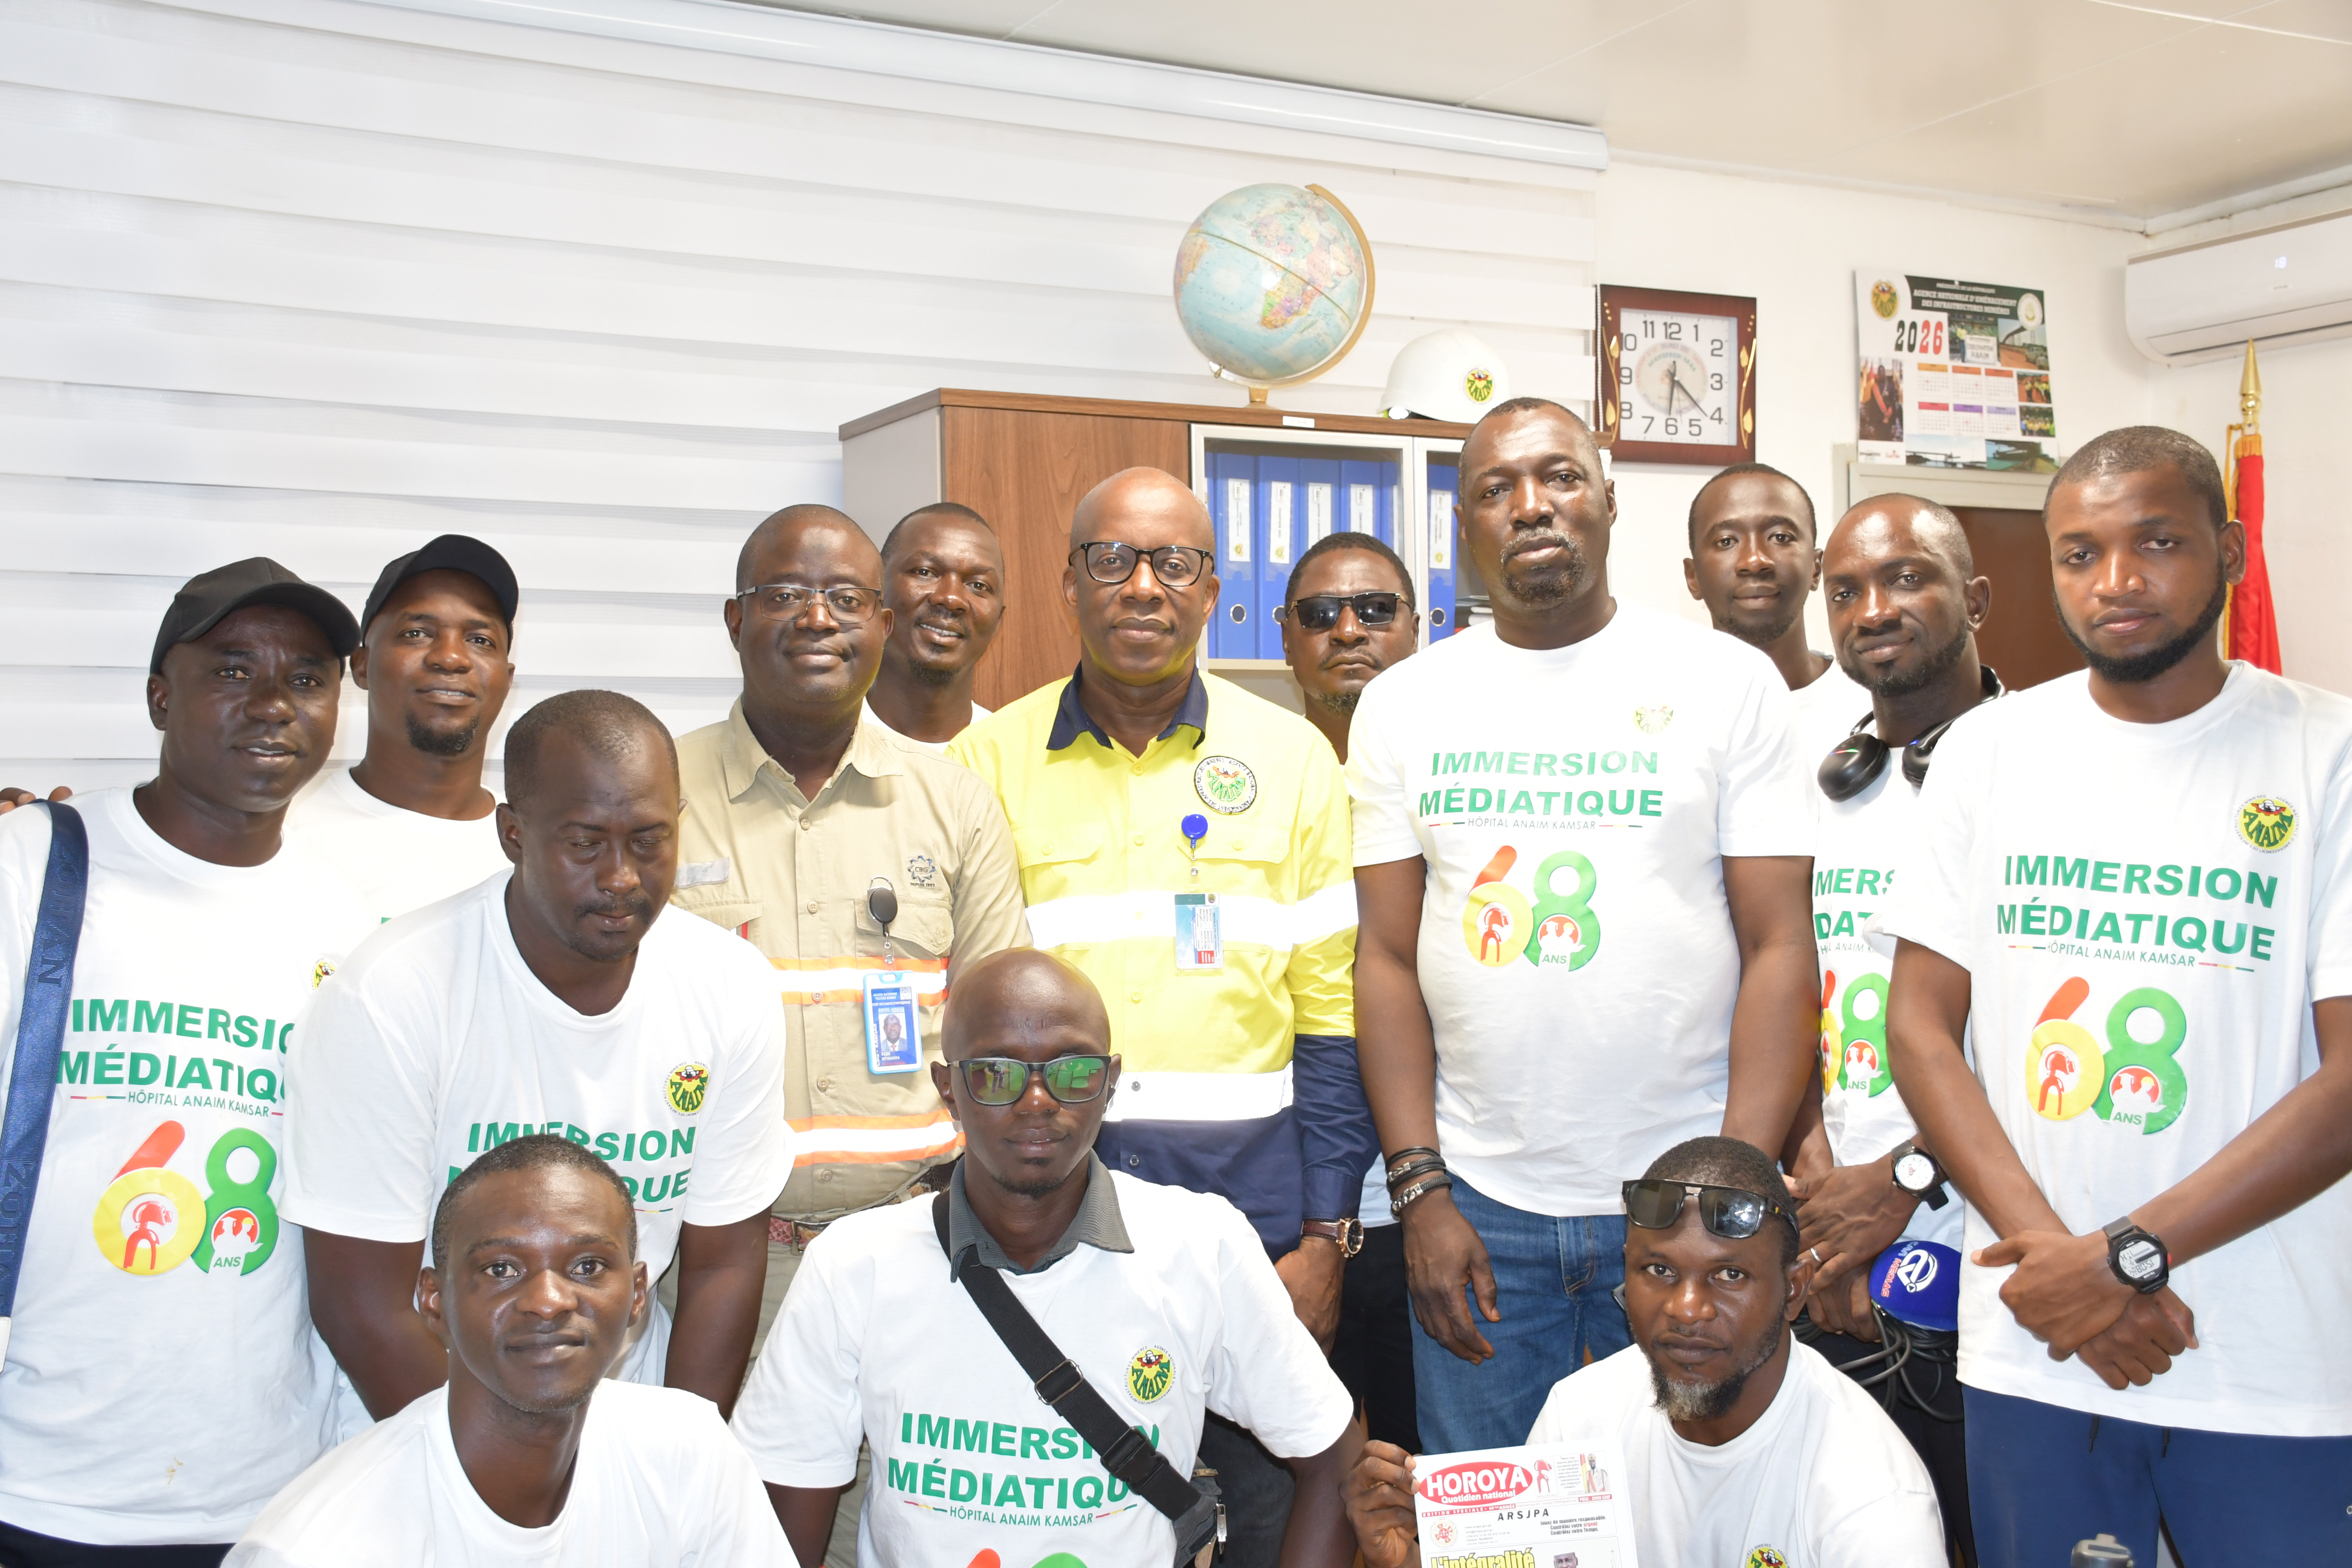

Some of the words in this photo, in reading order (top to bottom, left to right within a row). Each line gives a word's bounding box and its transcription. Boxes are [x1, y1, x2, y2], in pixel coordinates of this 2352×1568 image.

[1643, 320, 1654, 338] 11
[1663, 322, 1682, 340] 12
[1693, 324, 1698, 342] 1
[1894, 319, 1944, 355] 2026
[1621, 333, 1637, 351] 10
[1711, 339, 1723, 357] 2
[1621, 367, 1632, 384] 9
[1711, 373, 1723, 390] 3
[1467, 377, 1492, 401] ANAIM
[1621, 402, 1633, 419] 8
[1710, 407, 1723, 425] 4
[1642, 416, 1654, 434] 7
[1665, 418, 1678, 435] 6
[1688, 419, 1701, 436] 5
[1432, 751, 1658, 776] IMMERSION
[1207, 770, 1245, 801] ANAIM
[1419, 782, 1663, 818] MÉDIATIQUE
[2244, 795, 2266, 805] MINIERES
[2276, 796, 2293, 808] AGENCE
[1468, 816, 1508, 828] HÔPITAL
[1513, 818, 1548, 829] ANAIM
[1552, 820, 1595, 830] KAMSAR
[2234, 804, 2249, 845] INFRASTRUCTURES
[2243, 809, 2293, 847] ANAIM
[2259, 838, 2295, 854] D'AMENAGEMENT
[2004, 855, 2278, 909] IMMERSION
[1462, 845, 1601, 972] 68
[1997, 897, 2275, 961] MÉDIATIQUE
[1835, 942, 1864, 953] ANAIM
[2047, 940, 2090, 958] HÔPITAL
[2094, 947, 2135, 961] ANAIM
[2140, 952, 2195, 967] KAMSAR
[1542, 954, 1567, 964] ANS
[2025, 976, 2187, 1135] 68
[128, 1089, 178, 1106] HÔPITAL
[183, 1095, 226, 1109] ANAIM
[229, 1100, 270, 1118] KAMSAR
[663, 1075, 678, 1113] INFRASTRUCTURES
[670, 1074, 708, 1111] ANAIM
[2112, 1112, 2142, 1125] ANS
[93, 1119, 280, 1277] 68
[213, 1256, 241, 1268] ANS
[1881, 1258, 1902, 1298] MEDIAS
[1131, 1346, 1147, 1360] MINIERES
[1154, 1345, 1168, 1354] AGENCE
[1168, 1353, 1176, 1379] NATIONALE
[1124, 1361, 1138, 1402] INFRASTRUCTURES
[1132, 1359, 1170, 1400] ANAIM
[1145, 1381, 1175, 1405] D'AMENAGEMENT
[887, 1458, 1129, 1510] MÉDIATIQU
[1426, 1466, 1528, 1497] HOROYA
[1441, 1492, 1481, 1503] Quotidien
[1483, 1489, 1516, 1499] national
[950, 1505, 996, 1524] HÔPITAL
[1000, 1513, 1041, 1526] ANAIM
[1045, 1513, 1093, 1527] KAMSAR
